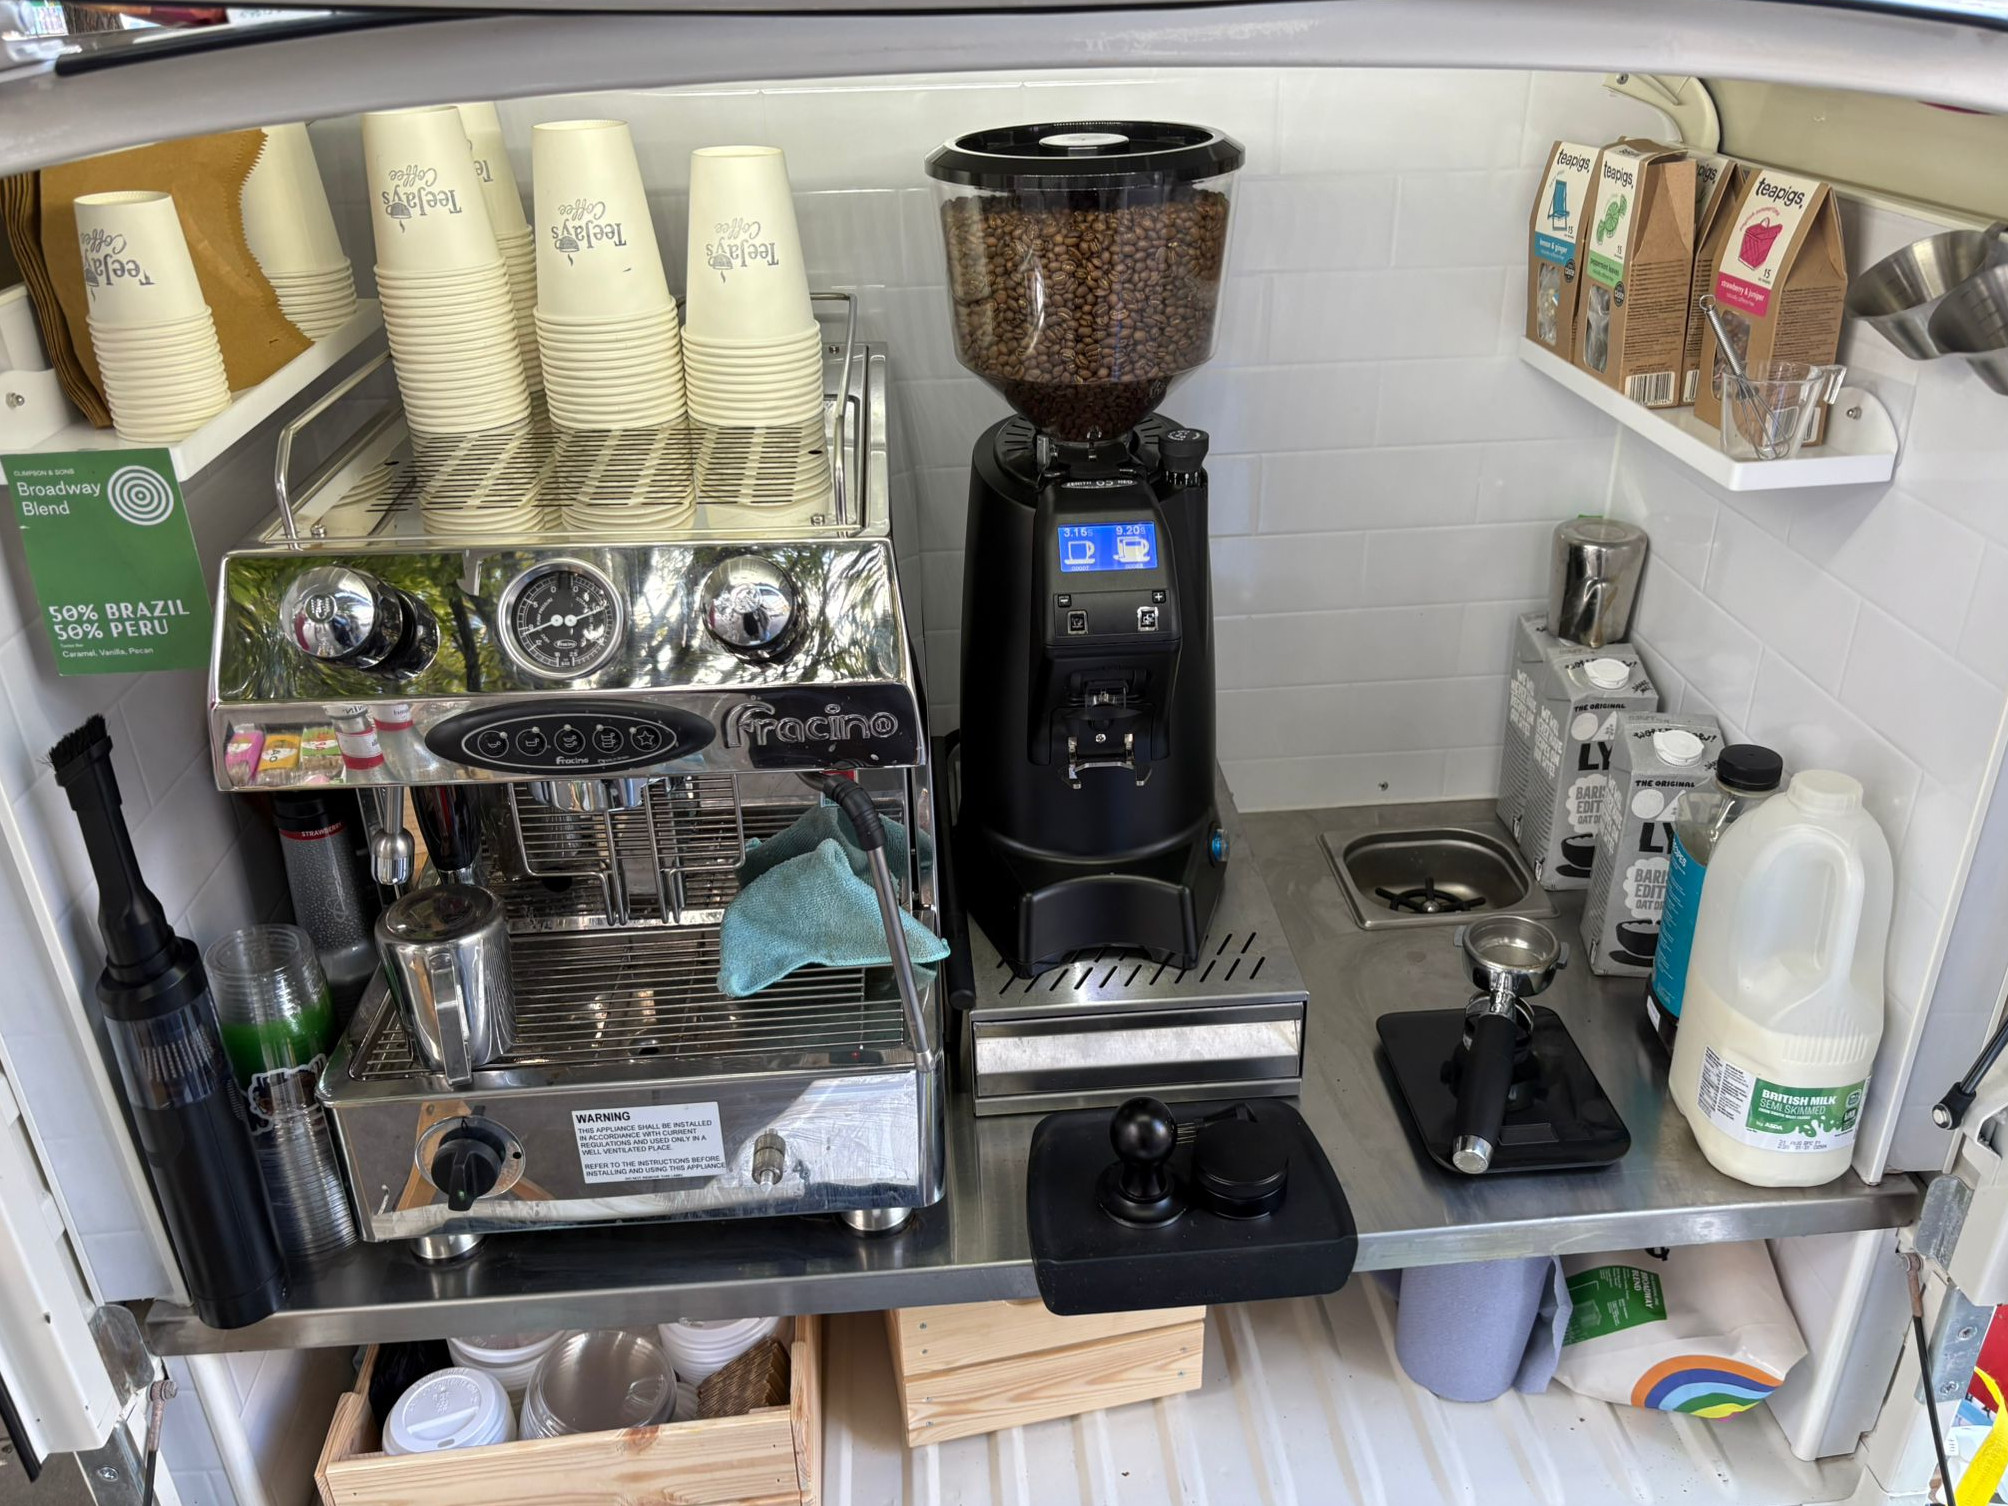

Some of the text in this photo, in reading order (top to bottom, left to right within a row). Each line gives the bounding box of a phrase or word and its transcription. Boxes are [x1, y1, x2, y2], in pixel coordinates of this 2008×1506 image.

[389, 164, 438, 187] Coffee
[382, 184, 462, 216] TeeJays
[559, 198, 606, 221] Coffee
[551, 219, 627, 249] TeeJays
[714, 218, 761, 240] Coffee
[1568, 226, 1574, 235] 15
[706, 237, 779, 267] TeeJays
[1764, 268, 1772, 279] 15
[17, 481, 101, 497] Broadway
[22, 501, 70, 516] Blend
[49, 599, 190, 622] 50% BRAZIL
[54, 619, 168, 641] 50% PERU
[62, 649, 98, 658] Caramel,
[129, 646, 154, 655] Pecan
[1574, 703, 1626, 712] THE ORIGINAL
[1654, 780, 1695, 788] ORIGINAL
[1576, 785, 1606, 800] BARI
[1577, 800, 1603, 814] EDIT
[1578, 815, 1592, 825] OAT
[301, 822, 342, 838] STRAWBERRY
[1634, 868, 1668, 884] BARI
[1634, 885, 1666, 899] EDIT
[1636, 900, 1652, 910] OAT
[1762, 1089, 1838, 1106] BRITISH MILK
[576, 1111, 631, 1124] WARNING
[1784, 1105, 1826, 1116] SKIMMED
[596, 1125, 636, 1133] APPLIANCE
[637, 1123, 661, 1131] SHALL
[673, 1120, 712, 1128] INSTALLED
[662, 1128, 697, 1136] CURRENT
[1764, 1122, 1782, 1131] ASDA
[580, 1140, 632, 1149] REGULATIONS
[650, 1137, 670, 1145] USED
[671, 1135, 692, 1143] ONLY
[604, 1146, 646, 1155] VENTILATED
[621, 1160, 636, 1168] THE
[638, 1158, 690, 1166] INSTRUCTIONS
[691, 1155, 720, 1163] BEFORE
[586, 1168, 627, 1177] INSTALLING
[645, 1166, 668, 1174] USING
[1632, 1269, 1642, 1292] BLEND
[1641, 1271, 1654, 1309] BROADWAY
